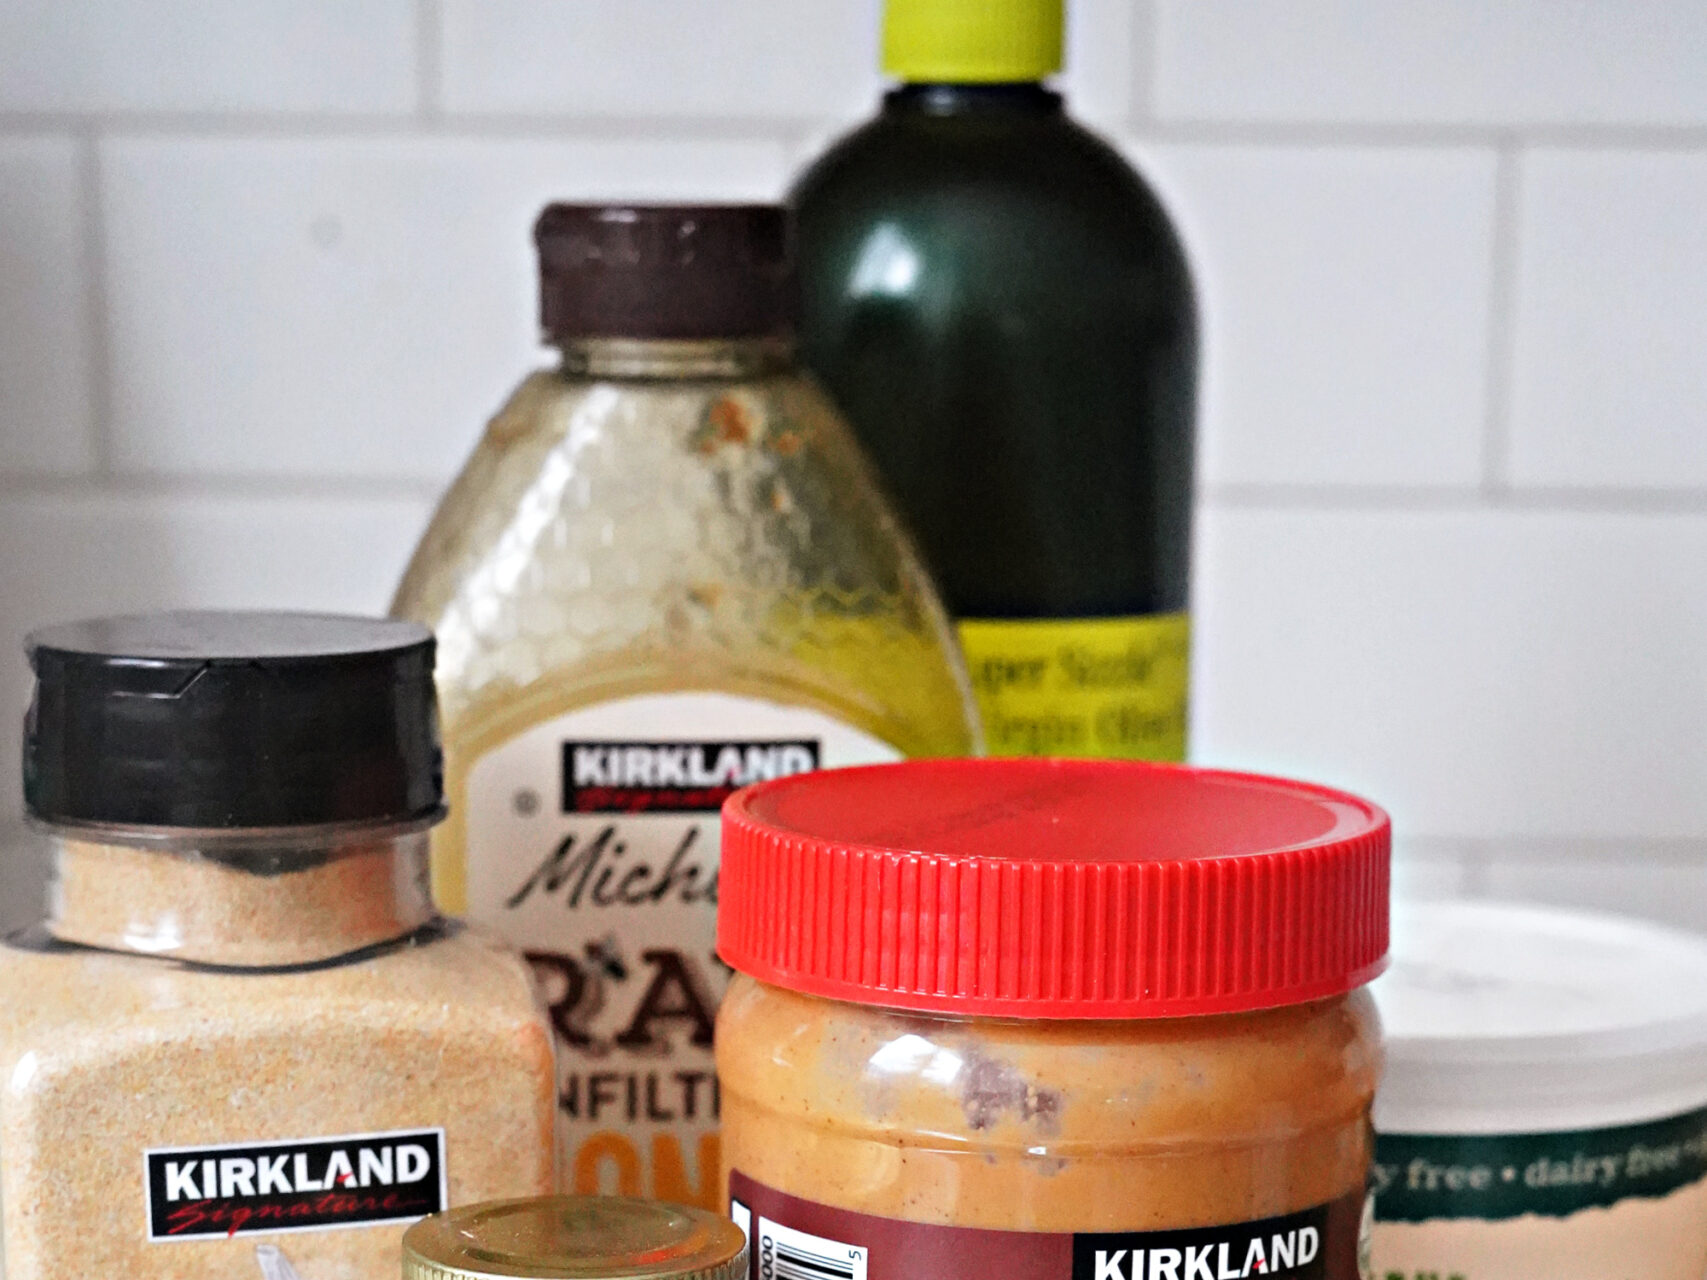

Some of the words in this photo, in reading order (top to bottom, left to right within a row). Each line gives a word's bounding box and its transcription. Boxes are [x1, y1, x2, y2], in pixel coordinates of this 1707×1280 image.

[506, 826, 718, 908] Mich
[523, 947, 735, 1054] RA
[558, 1072, 719, 1121] NFILT
[164, 1143, 431, 1201] KIRKLAND
[1406, 1156, 1494, 1191] free
[1523, 1154, 1619, 1190] dairy
[166, 1193, 425, 1237] Signature
[848, 1250, 863, 1261] 5
